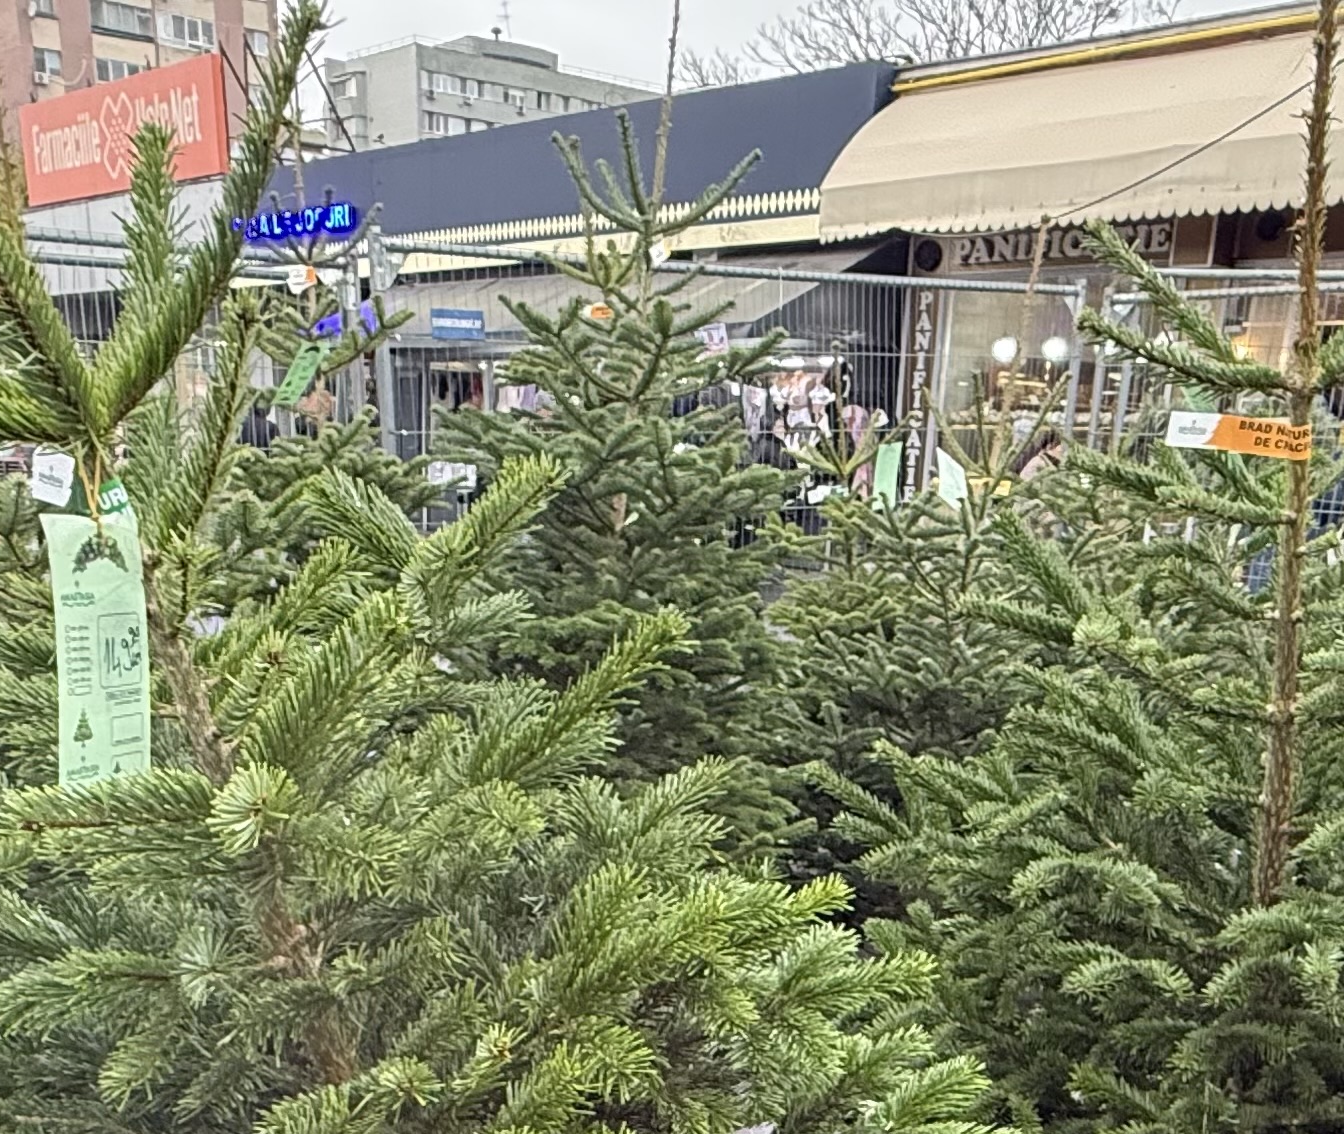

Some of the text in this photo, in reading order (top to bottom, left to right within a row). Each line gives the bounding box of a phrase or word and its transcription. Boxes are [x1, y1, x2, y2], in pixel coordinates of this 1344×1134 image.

[1239, 420, 1310, 441] BRAD NTUR
[1254, 436, 1272, 448] DE
